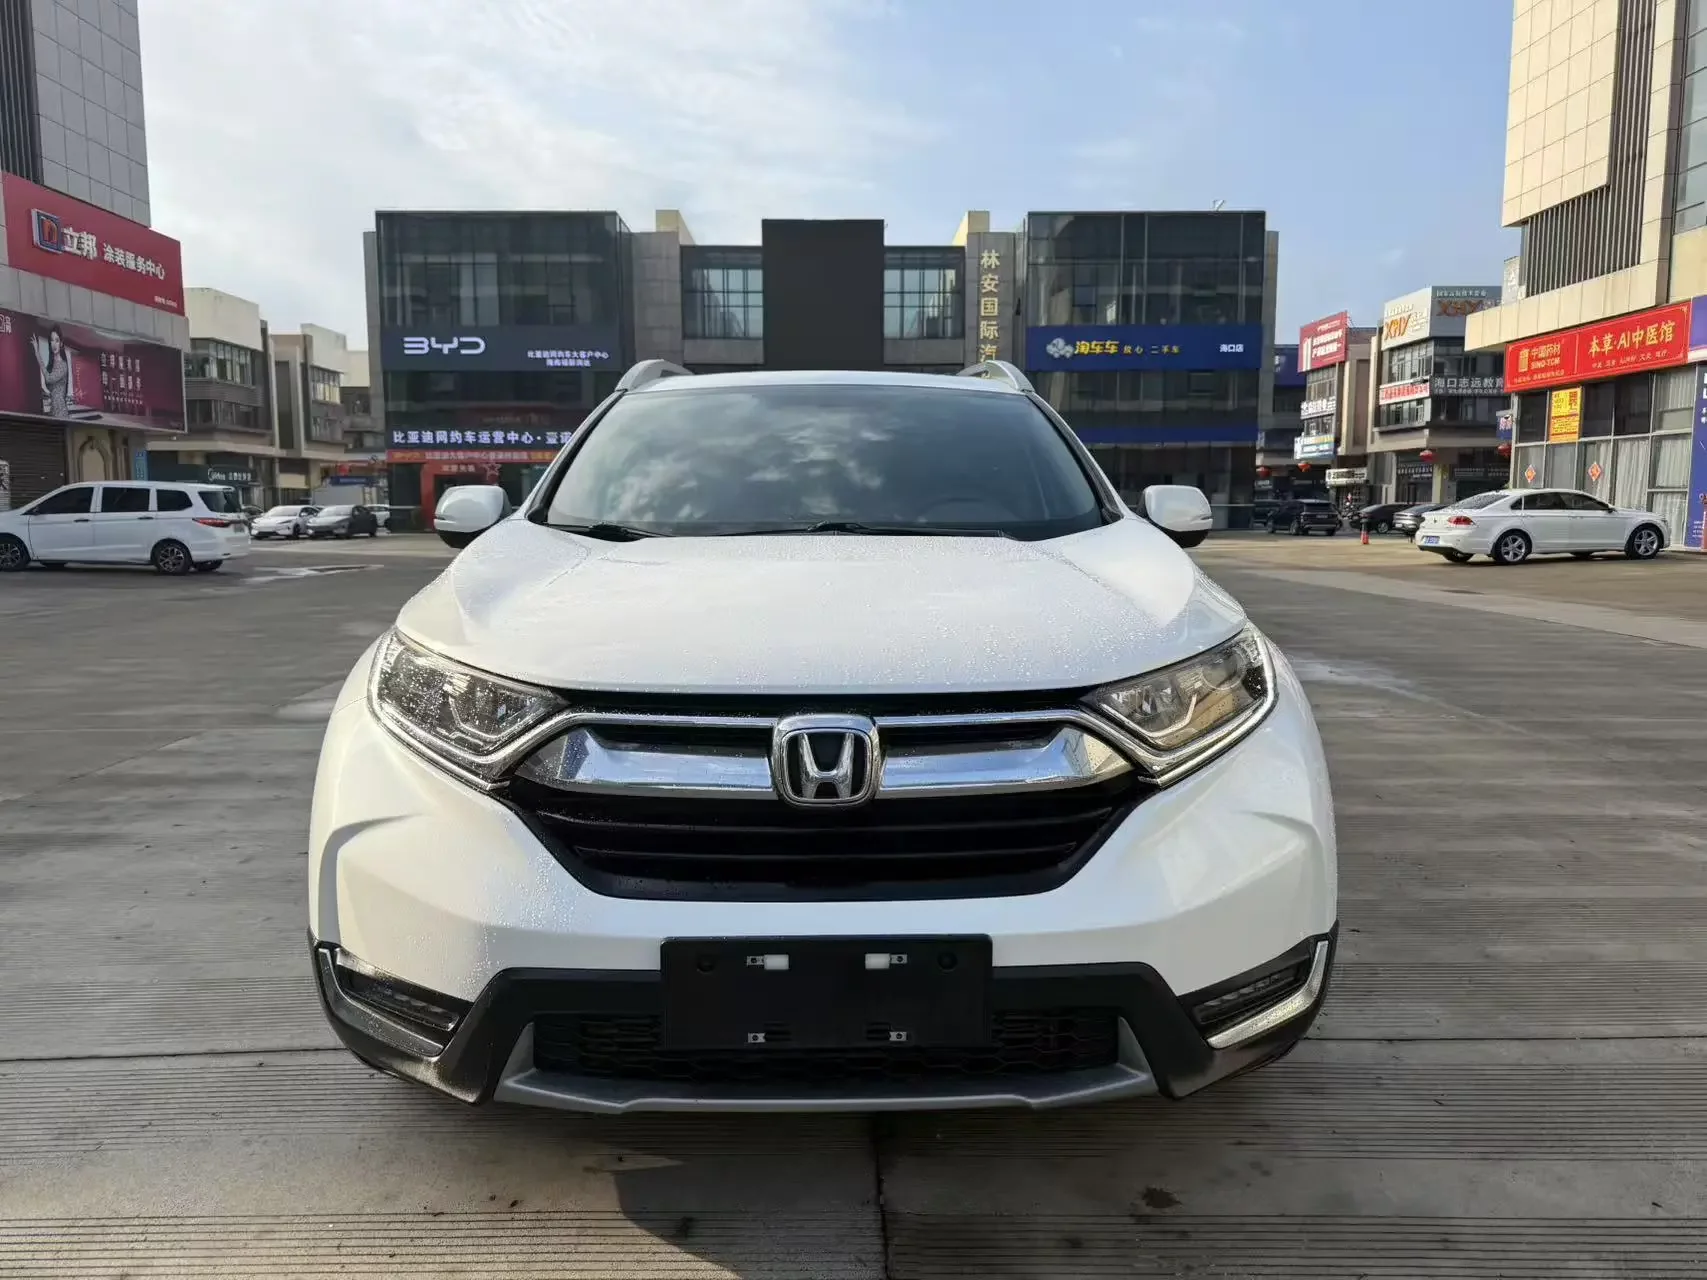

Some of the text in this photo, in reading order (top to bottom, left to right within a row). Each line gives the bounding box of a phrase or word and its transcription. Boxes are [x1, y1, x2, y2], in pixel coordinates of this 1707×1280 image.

[62, 227, 165, 280] 立邦 涂装服务中心
[980, 249, 1000, 378] 林安国际汽
[403, 336, 486, 355] BYD
[1074, 340, 1120, 355] 淘车车
